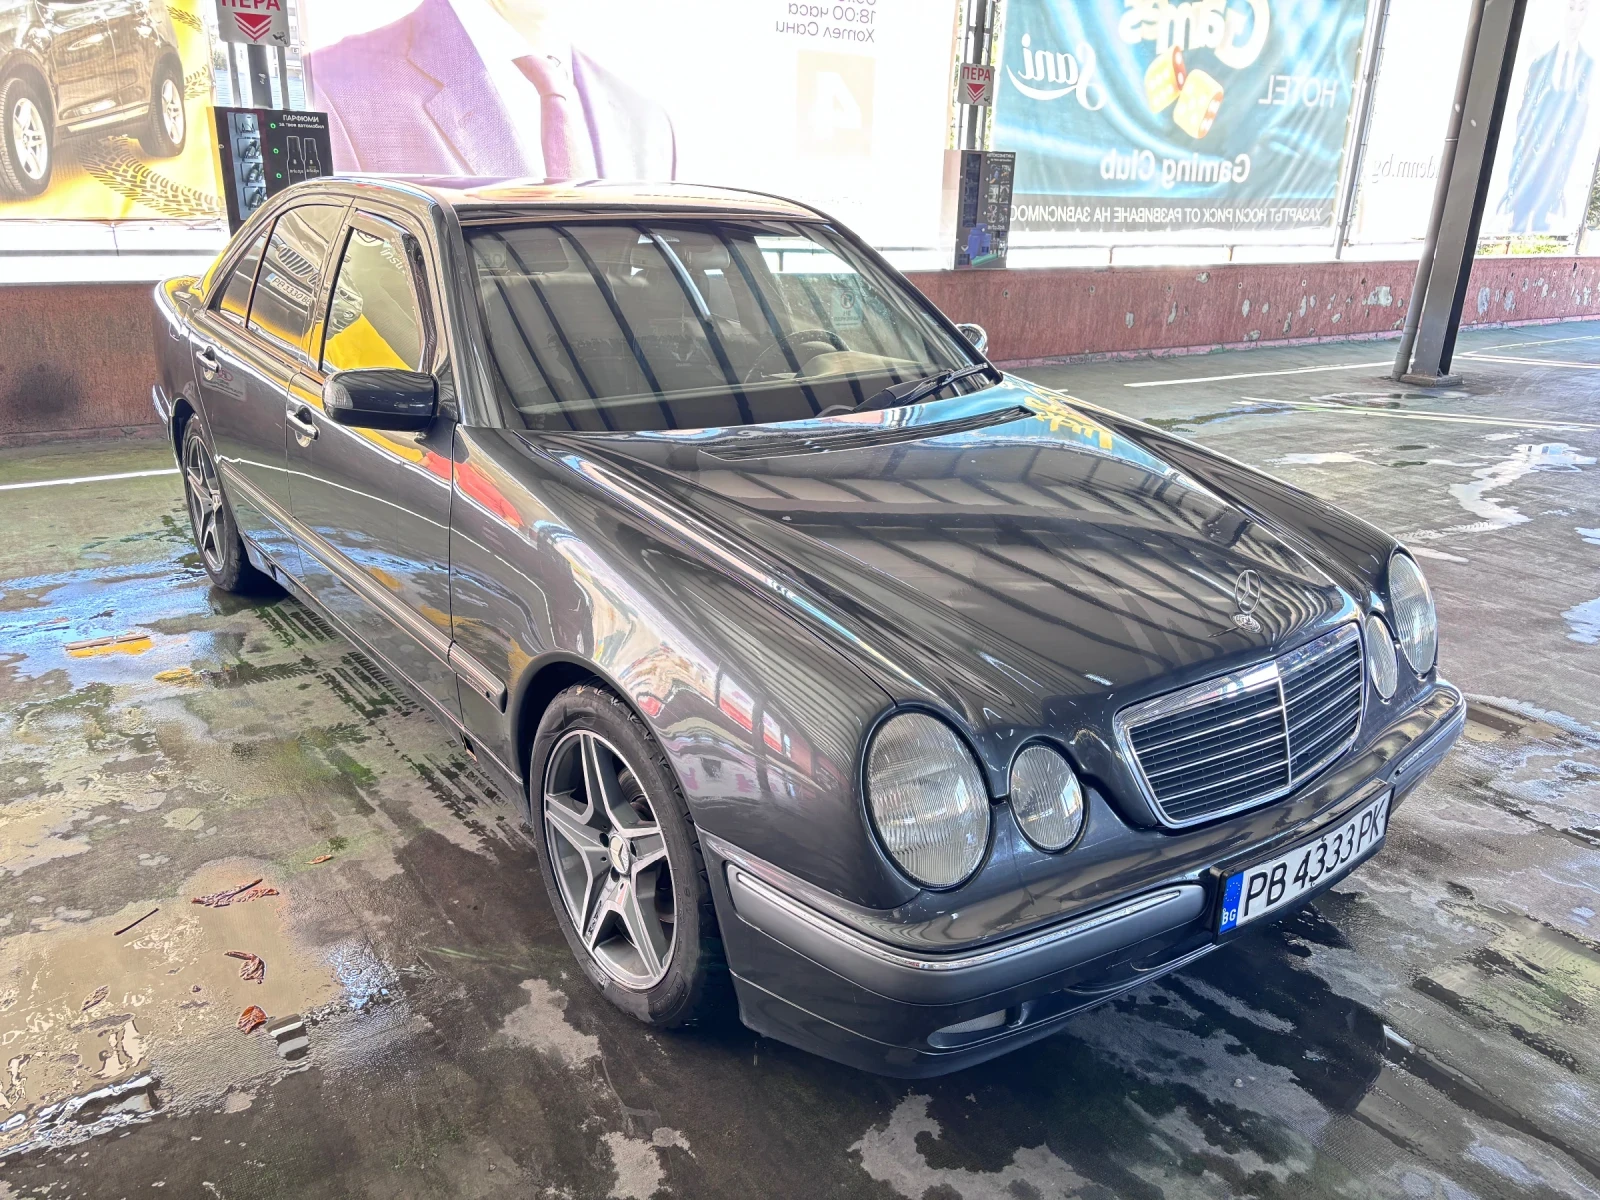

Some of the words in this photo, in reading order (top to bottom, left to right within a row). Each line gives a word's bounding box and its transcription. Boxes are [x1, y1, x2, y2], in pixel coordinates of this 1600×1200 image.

[962, 66, 990, 81] ПЕРА
[282, 114, 319, 123] ПАРФЮМИ
[1244, 862, 1287, 917] PB
[1293, 826, 1355, 890] 4333
[1356, 797, 1386, 854] PK
[1222, 910, 1236, 925] BG
